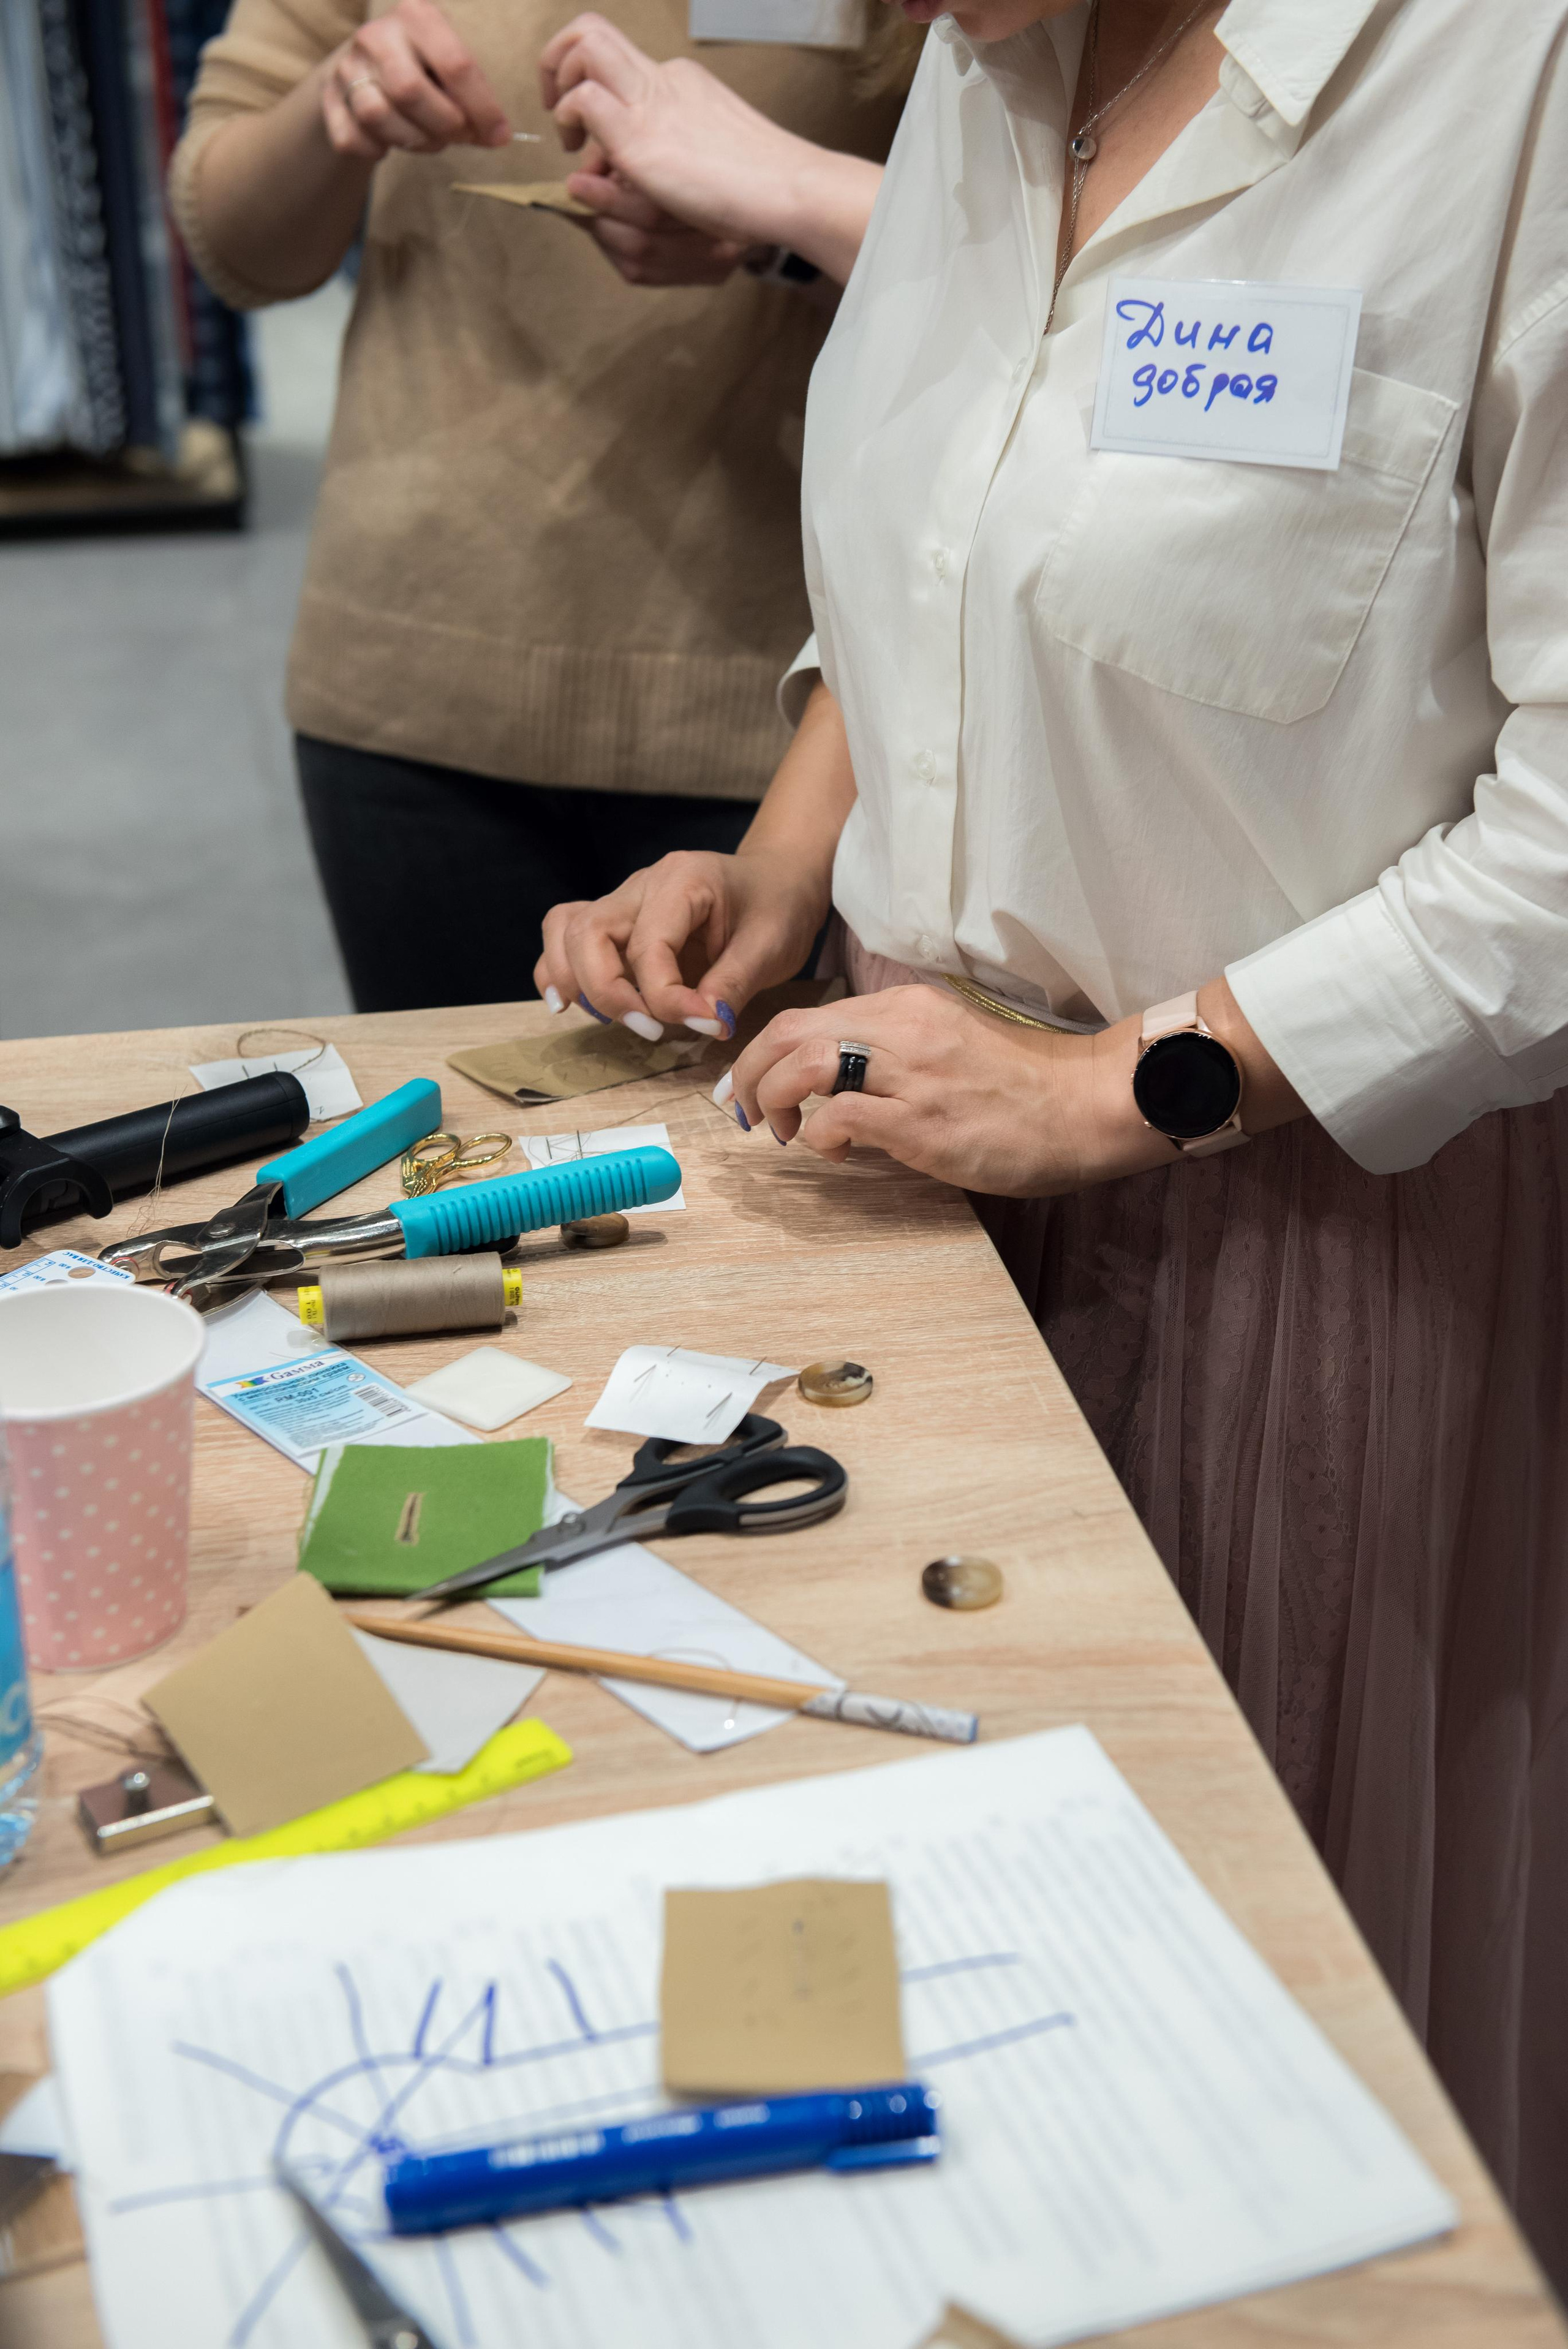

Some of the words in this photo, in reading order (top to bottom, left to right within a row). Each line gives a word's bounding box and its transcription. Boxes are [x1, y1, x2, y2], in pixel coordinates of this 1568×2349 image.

[1115, 299, 1273, 355] Дина
[1132, 363, 1278, 412] добрая
[77, 1257, 96, 1265] ДЛЯ
[92, 1263, 130, 1279] КАЧЕСТВО
